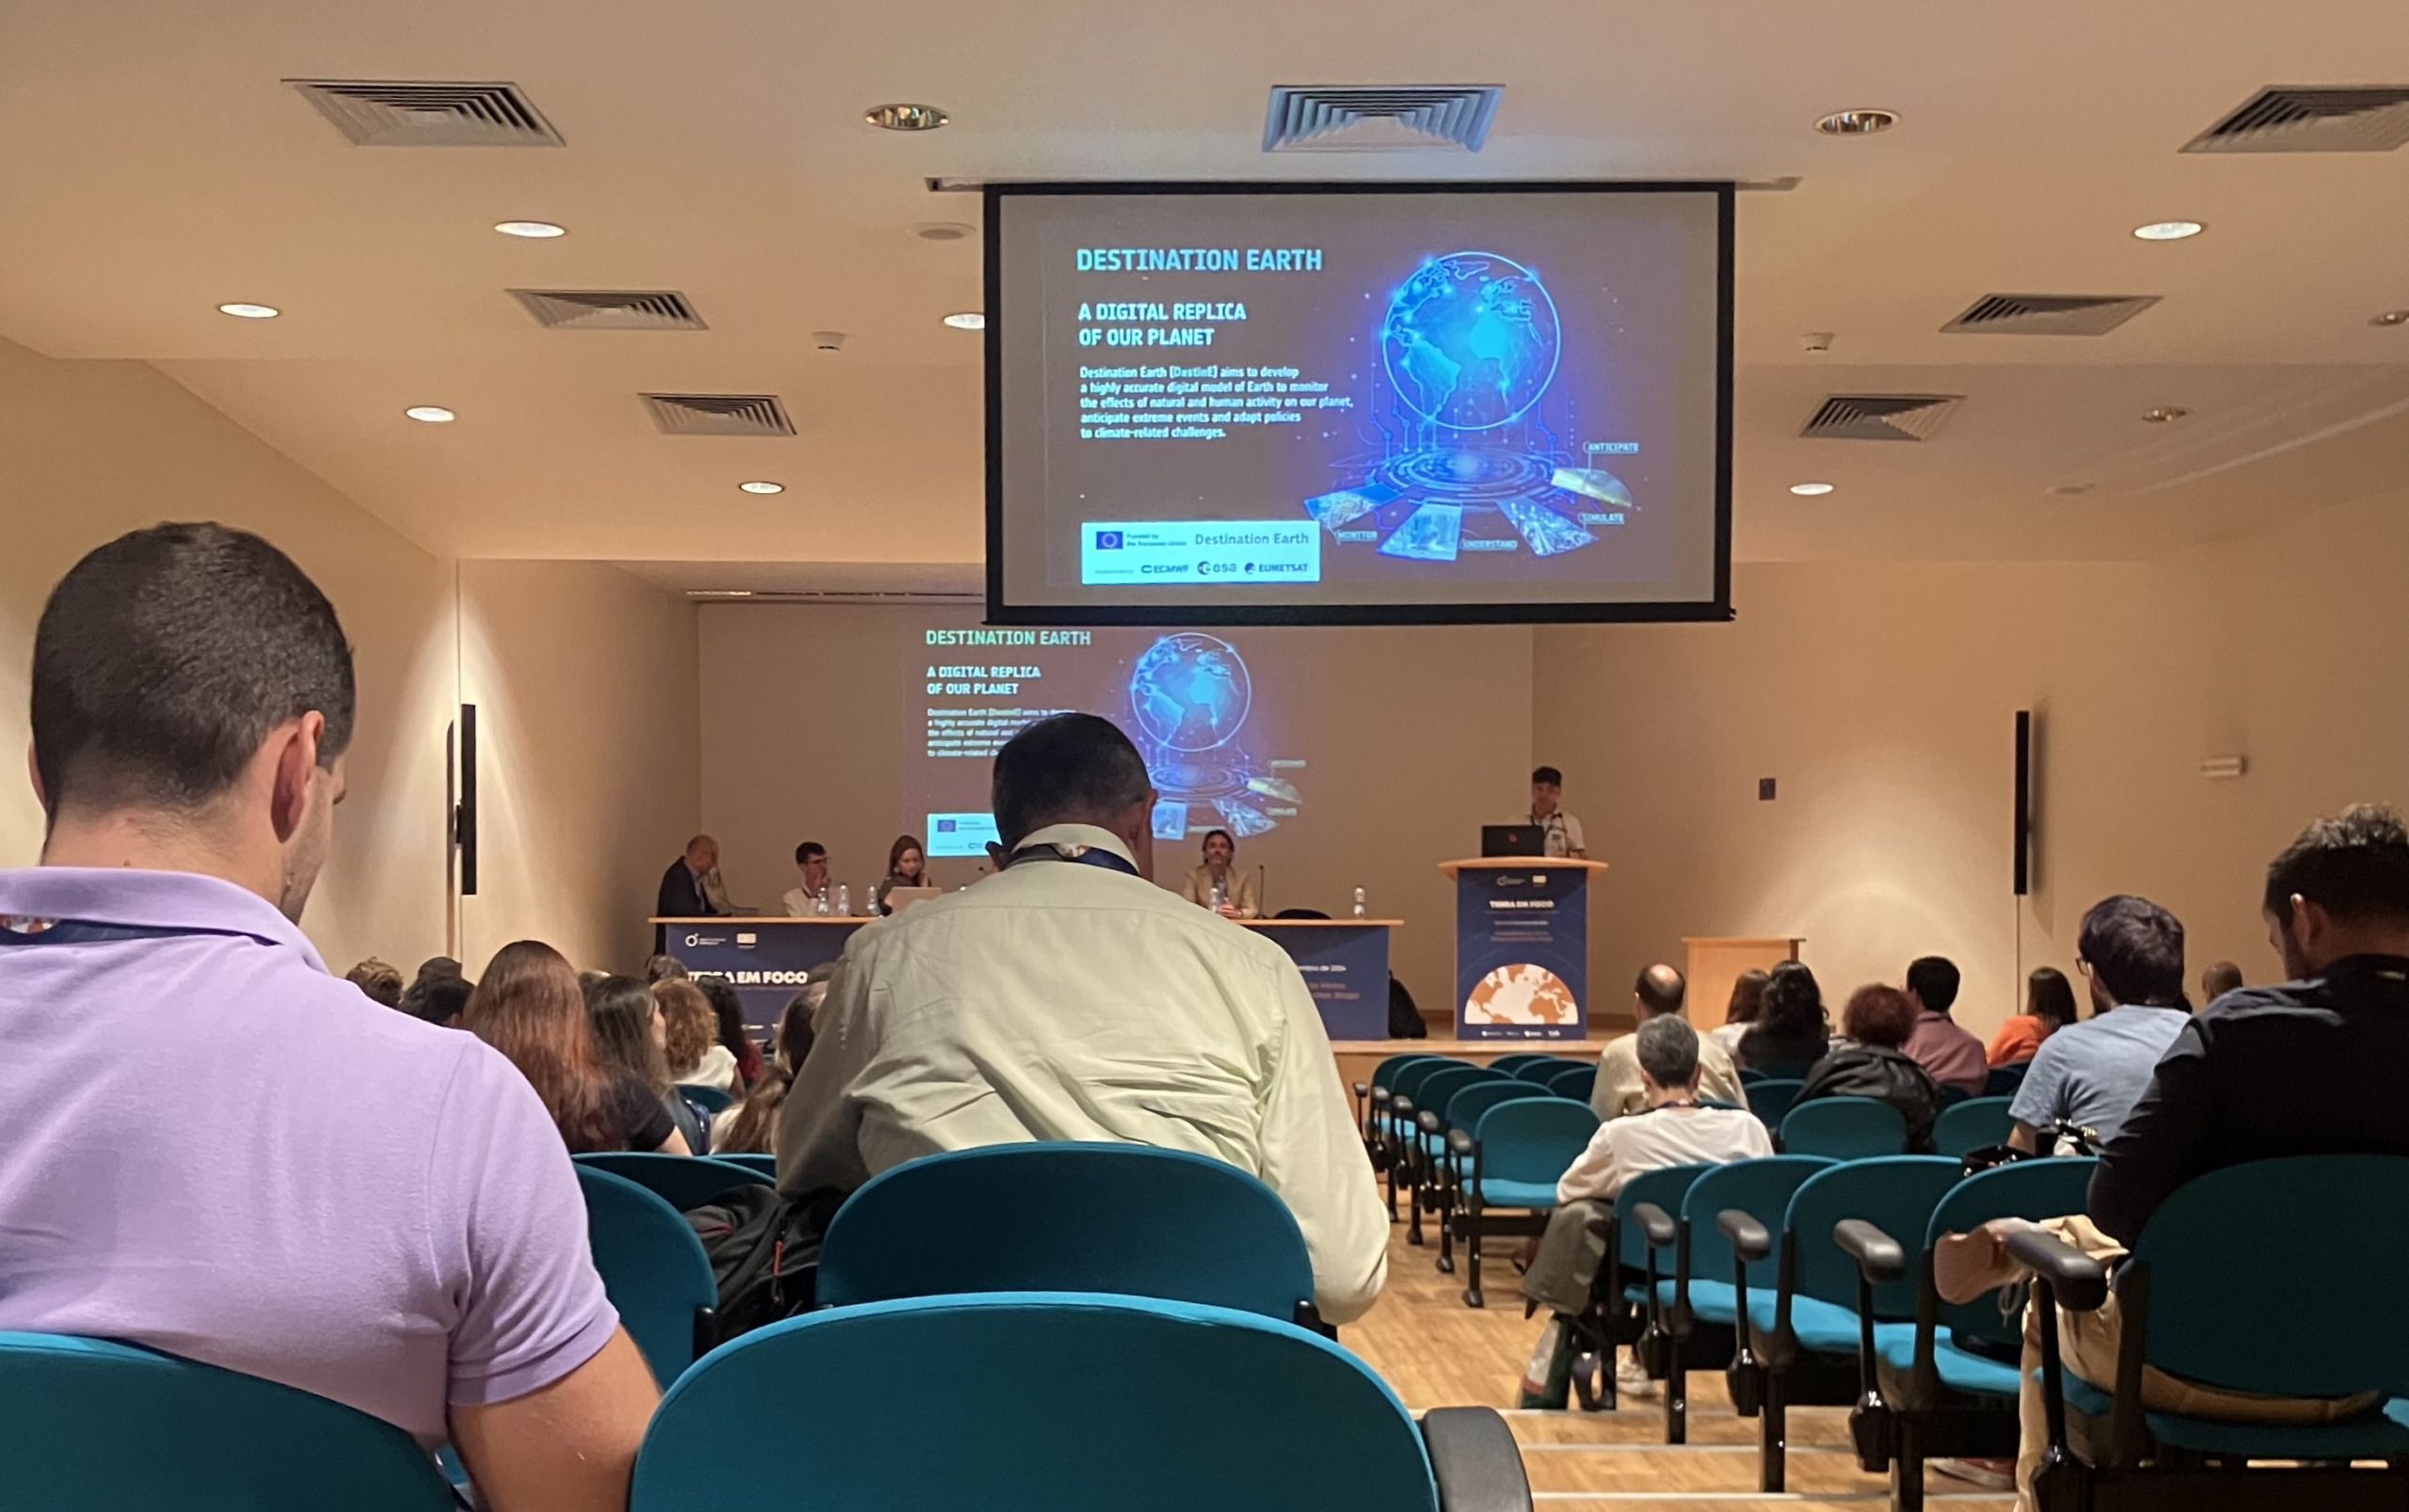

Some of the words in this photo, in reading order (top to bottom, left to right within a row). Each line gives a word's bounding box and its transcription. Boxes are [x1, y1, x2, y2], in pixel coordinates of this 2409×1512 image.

[1077, 248, 1239, 271] DESTINATION
[1246, 248, 1323, 271] EARTH
[1078, 303, 1092, 321] A
[1096, 303, 1169, 321] DIGITAL
[1173, 302, 1247, 320] REPLICA
[1078, 328, 1102, 346] OF
[1107, 328, 1143, 346] OUR
[1147, 328, 1215, 346] PLANET
[1079, 365, 1138, 378] Destination
[1140, 365, 1167, 378] Earth
[1220, 366, 1245, 377] aims
[1247, 366, 1258, 377] to
[1260, 365, 1300, 379] develop
[1079, 384, 1088, 393] a
[1090, 381, 1122, 395] highly
[1123, 382, 1165, 393] accurate
[1167, 381, 1199, 395] digital
[1201, 381, 1233, 392] model
[1235, 381, 1245, 392] of
[1247, 381, 1274, 392] Earth
[1276, 382, 1287, 392] to
[1289, 381, 1329, 392] monitor
[1079, 397, 1098, 408] the
[1100, 396, 1135, 408] effects
[1137, 396, 1148, 408] of
[1149, 396, 1186, 407] natural
[1187, 396, 1207, 407] and
[1208, 396, 1244, 407] human
[1245, 396, 1283, 409] activity
[1284, 398, 1298, 407] on
[1299, 397, 1317, 406] our
[1318, 395, 1353, 408] planet,
[1080, 412, 1130, 425] anticipate
[1132, 413, 1174, 423] extreme
[1175, 413, 1210, 423] events
[1211, 411, 1232, 422] and
[1233, 411, 1262, 424] adapt
[1264, 411, 1301, 424] policies
[1080, 428, 1093, 438] to
[1094, 426, 1170, 438] climate-related
[1171, 426, 1226, 439] challenges.
[1195, 533, 1269, 545] Destination
[1273, 533, 1309, 544] Earth
[1154, 565, 1189, 574] ECMWF
[1258, 563, 1308, 573] EUMETSAT
[926, 629, 1035, 645] DESTINATION
[1040, 630, 1092, 645] EARTH
[927, 666, 936, 677] A
[938, 666, 988, 677] DIGITAL
[991, 666, 1042, 677] REPLICA
[927, 683, 943, 694] OF
[946, 683, 971, 694] OUR
[973, 683, 1019, 694] PLANET
[736, 971, 761, 984] EM
[762, 971, 808, 984] FOCO
